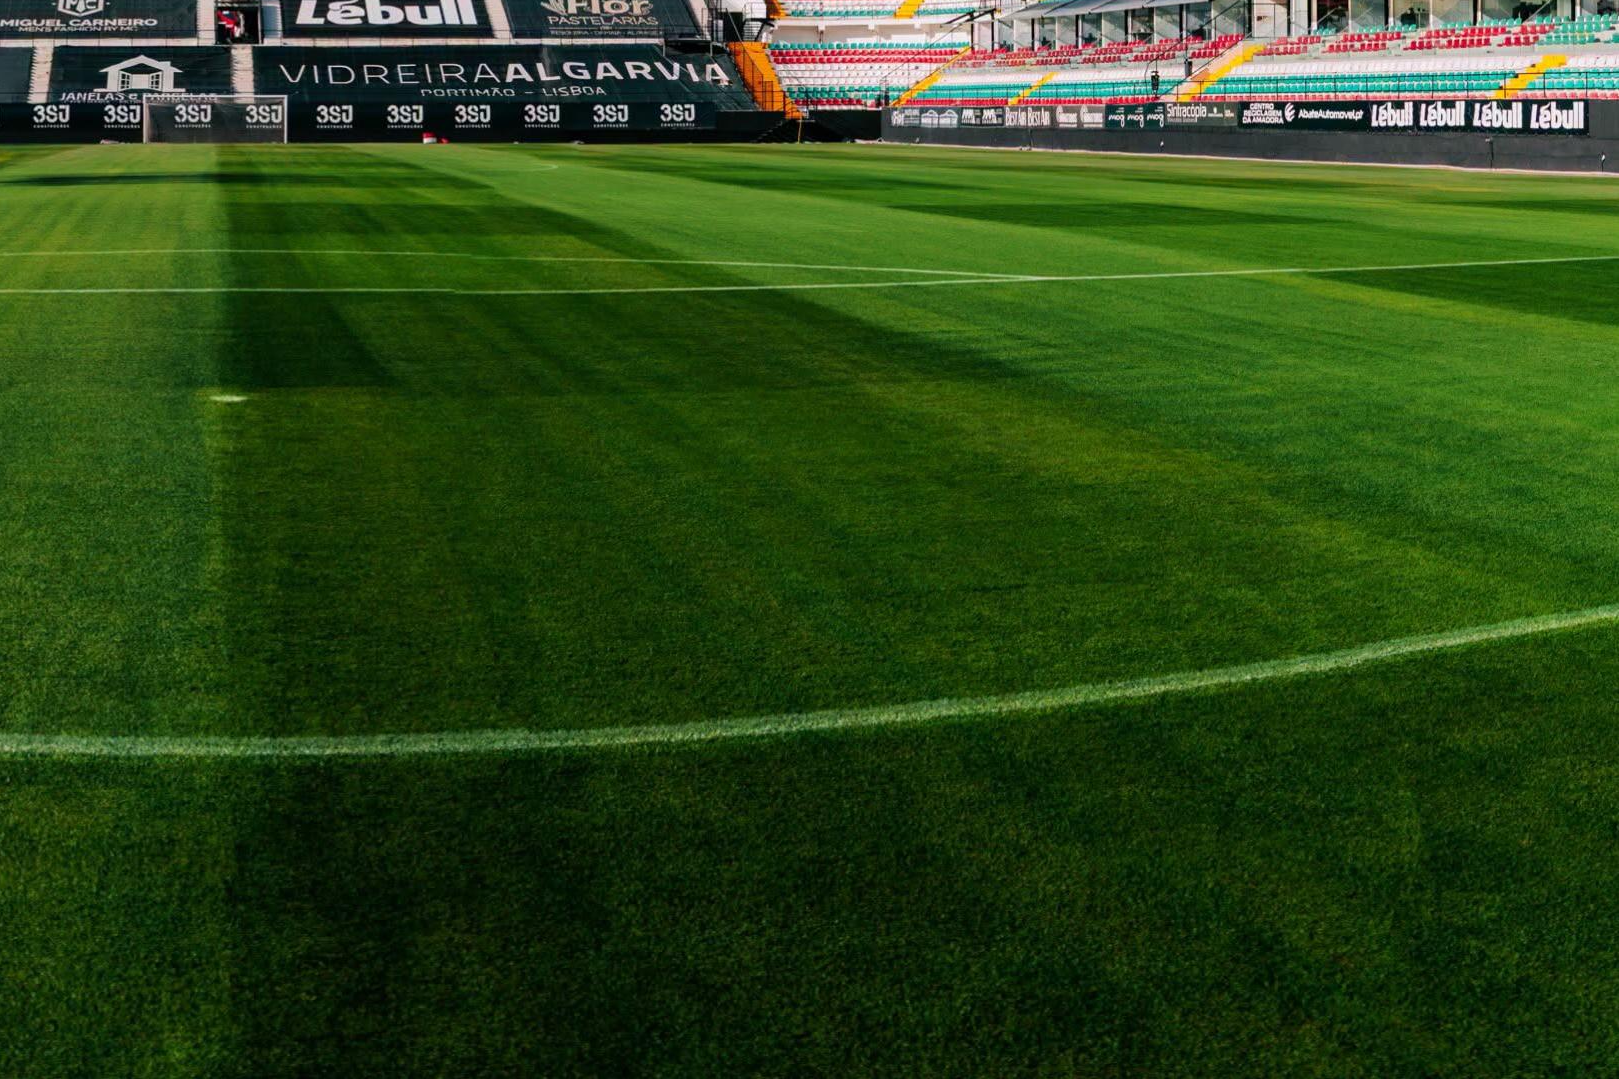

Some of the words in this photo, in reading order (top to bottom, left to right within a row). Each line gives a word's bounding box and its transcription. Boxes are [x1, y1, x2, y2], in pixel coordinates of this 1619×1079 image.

[0, 19, 66, 27] MIGUEL
[68, 18, 159, 27] CARNEIRO
[547, 16, 659, 26] PASTELARIAS
[59, 92, 125, 101] JANELAS
[420, 87, 516, 97] PORTIMÃO
[542, 85, 607, 97] LISBOA
[34, 105, 69, 123] 3SJ
[104, 105, 140, 123] 3SJ
[175, 105, 211, 123] 3SJ
[246, 105, 282, 123] 3SJ
[317, 105, 352, 123] 3SJ
[388, 105, 423, 123] 3SJ
[455, 105, 490, 123] 3SJ
[525, 105, 559, 122] 3SJ
[594, 105, 628, 122] 3SJ
[660, 104, 695, 122] 3SJ
[1253, 116, 1284, 124] AMADORA
